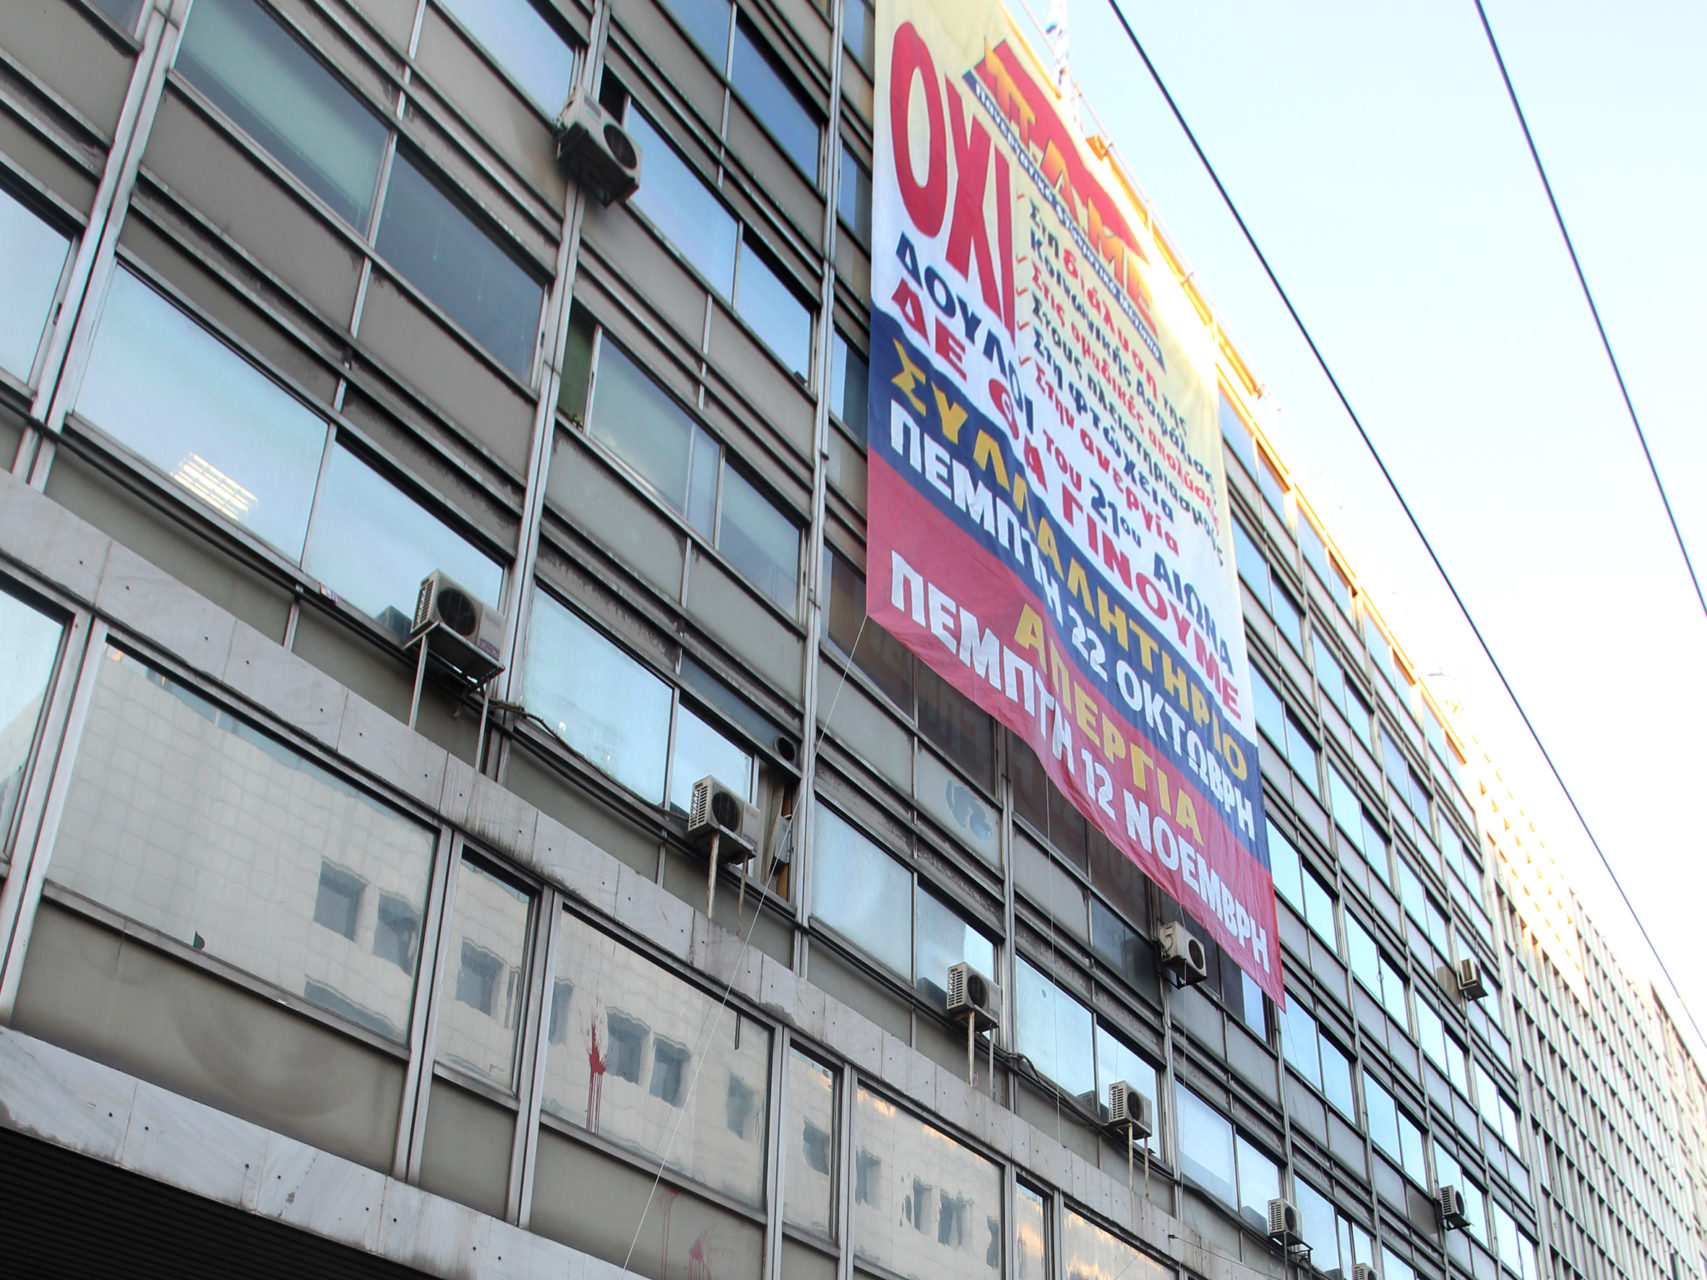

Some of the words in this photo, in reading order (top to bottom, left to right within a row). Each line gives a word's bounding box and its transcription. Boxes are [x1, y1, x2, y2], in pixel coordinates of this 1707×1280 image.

[890, 21, 1015, 348] ΟΧΙ
[1029, 197, 1060, 260] Στη
[1063, 248, 1159, 402] διάλυση
[1161, 391, 1187, 437] της
[1030, 227, 1132, 388] Κοινωνικής
[1032, 290, 1083, 381] Στους
[1032, 260, 1066, 328] Στις
[1071, 321, 1145, 436] ομαδικές
[1033, 324, 1063, 391] Στη
[1068, 380, 1175, 525] φτώχεια
[890, 338, 1249, 783] ΣΥΛΛΑΛΗΤΗΡΙΟ
[891, 277, 968, 382] ΔΕ
[988, 377, 1049, 494] ΘΑ
[1061, 481, 1241, 722] ΓΙΝΟΥΜΕ
[895, 230, 1034, 435] ΔΟΥΛΟΙ
[1089, 476, 1143, 550] 21ου
[1153, 551, 1235, 678] ΑΙΩΝΑ
[1034, 359, 1075, 430] Στην
[1079, 427, 1180, 557] ανεργία
[890, 397, 1064, 627] ΠΕΜΠΤΗ
[1070, 604, 1109, 683] 22
[1115, 657, 1257, 843] ΟΚΤΩΒΡΗ
[1014, 602, 1204, 847] ΑΠΕΡΓΙΑ
[890, 549, 1077, 776] ΠΕΜΠΤΗ
[1081, 743, 1117, 825] 12
[1125, 790, 1271, 976] ΝΟΕΜΒΡΗ
